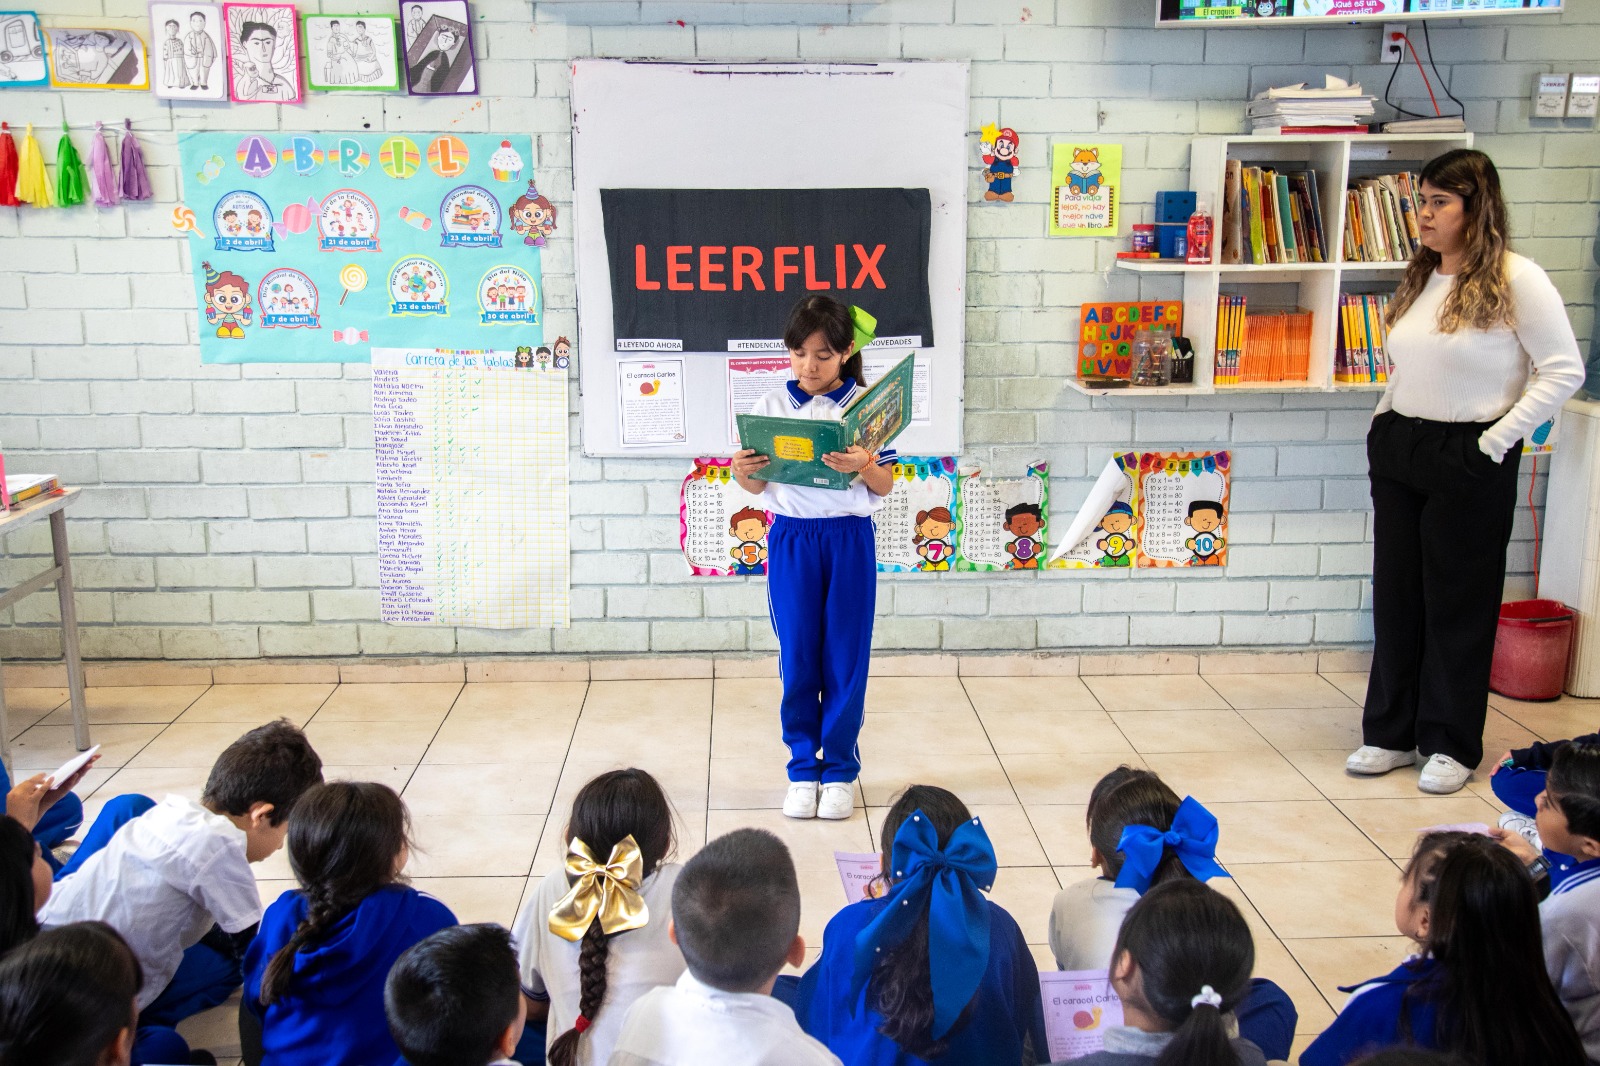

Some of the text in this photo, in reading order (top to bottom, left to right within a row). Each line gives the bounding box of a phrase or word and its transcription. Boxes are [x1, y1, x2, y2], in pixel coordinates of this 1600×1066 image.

[635, 244, 886, 292] LEERFLIX
[406, 352, 514, 367] Carrera de las tablas
[929, 544, 943, 560] 7
[1017, 539, 1032, 558] 8
[1109, 536, 1124, 555] 9
[1195, 538, 1212, 552] 10
[744, 546, 757, 564] 5
[1063, 996, 1093, 1005] caracol
[1095, 994, 1120, 1002] Carlo
